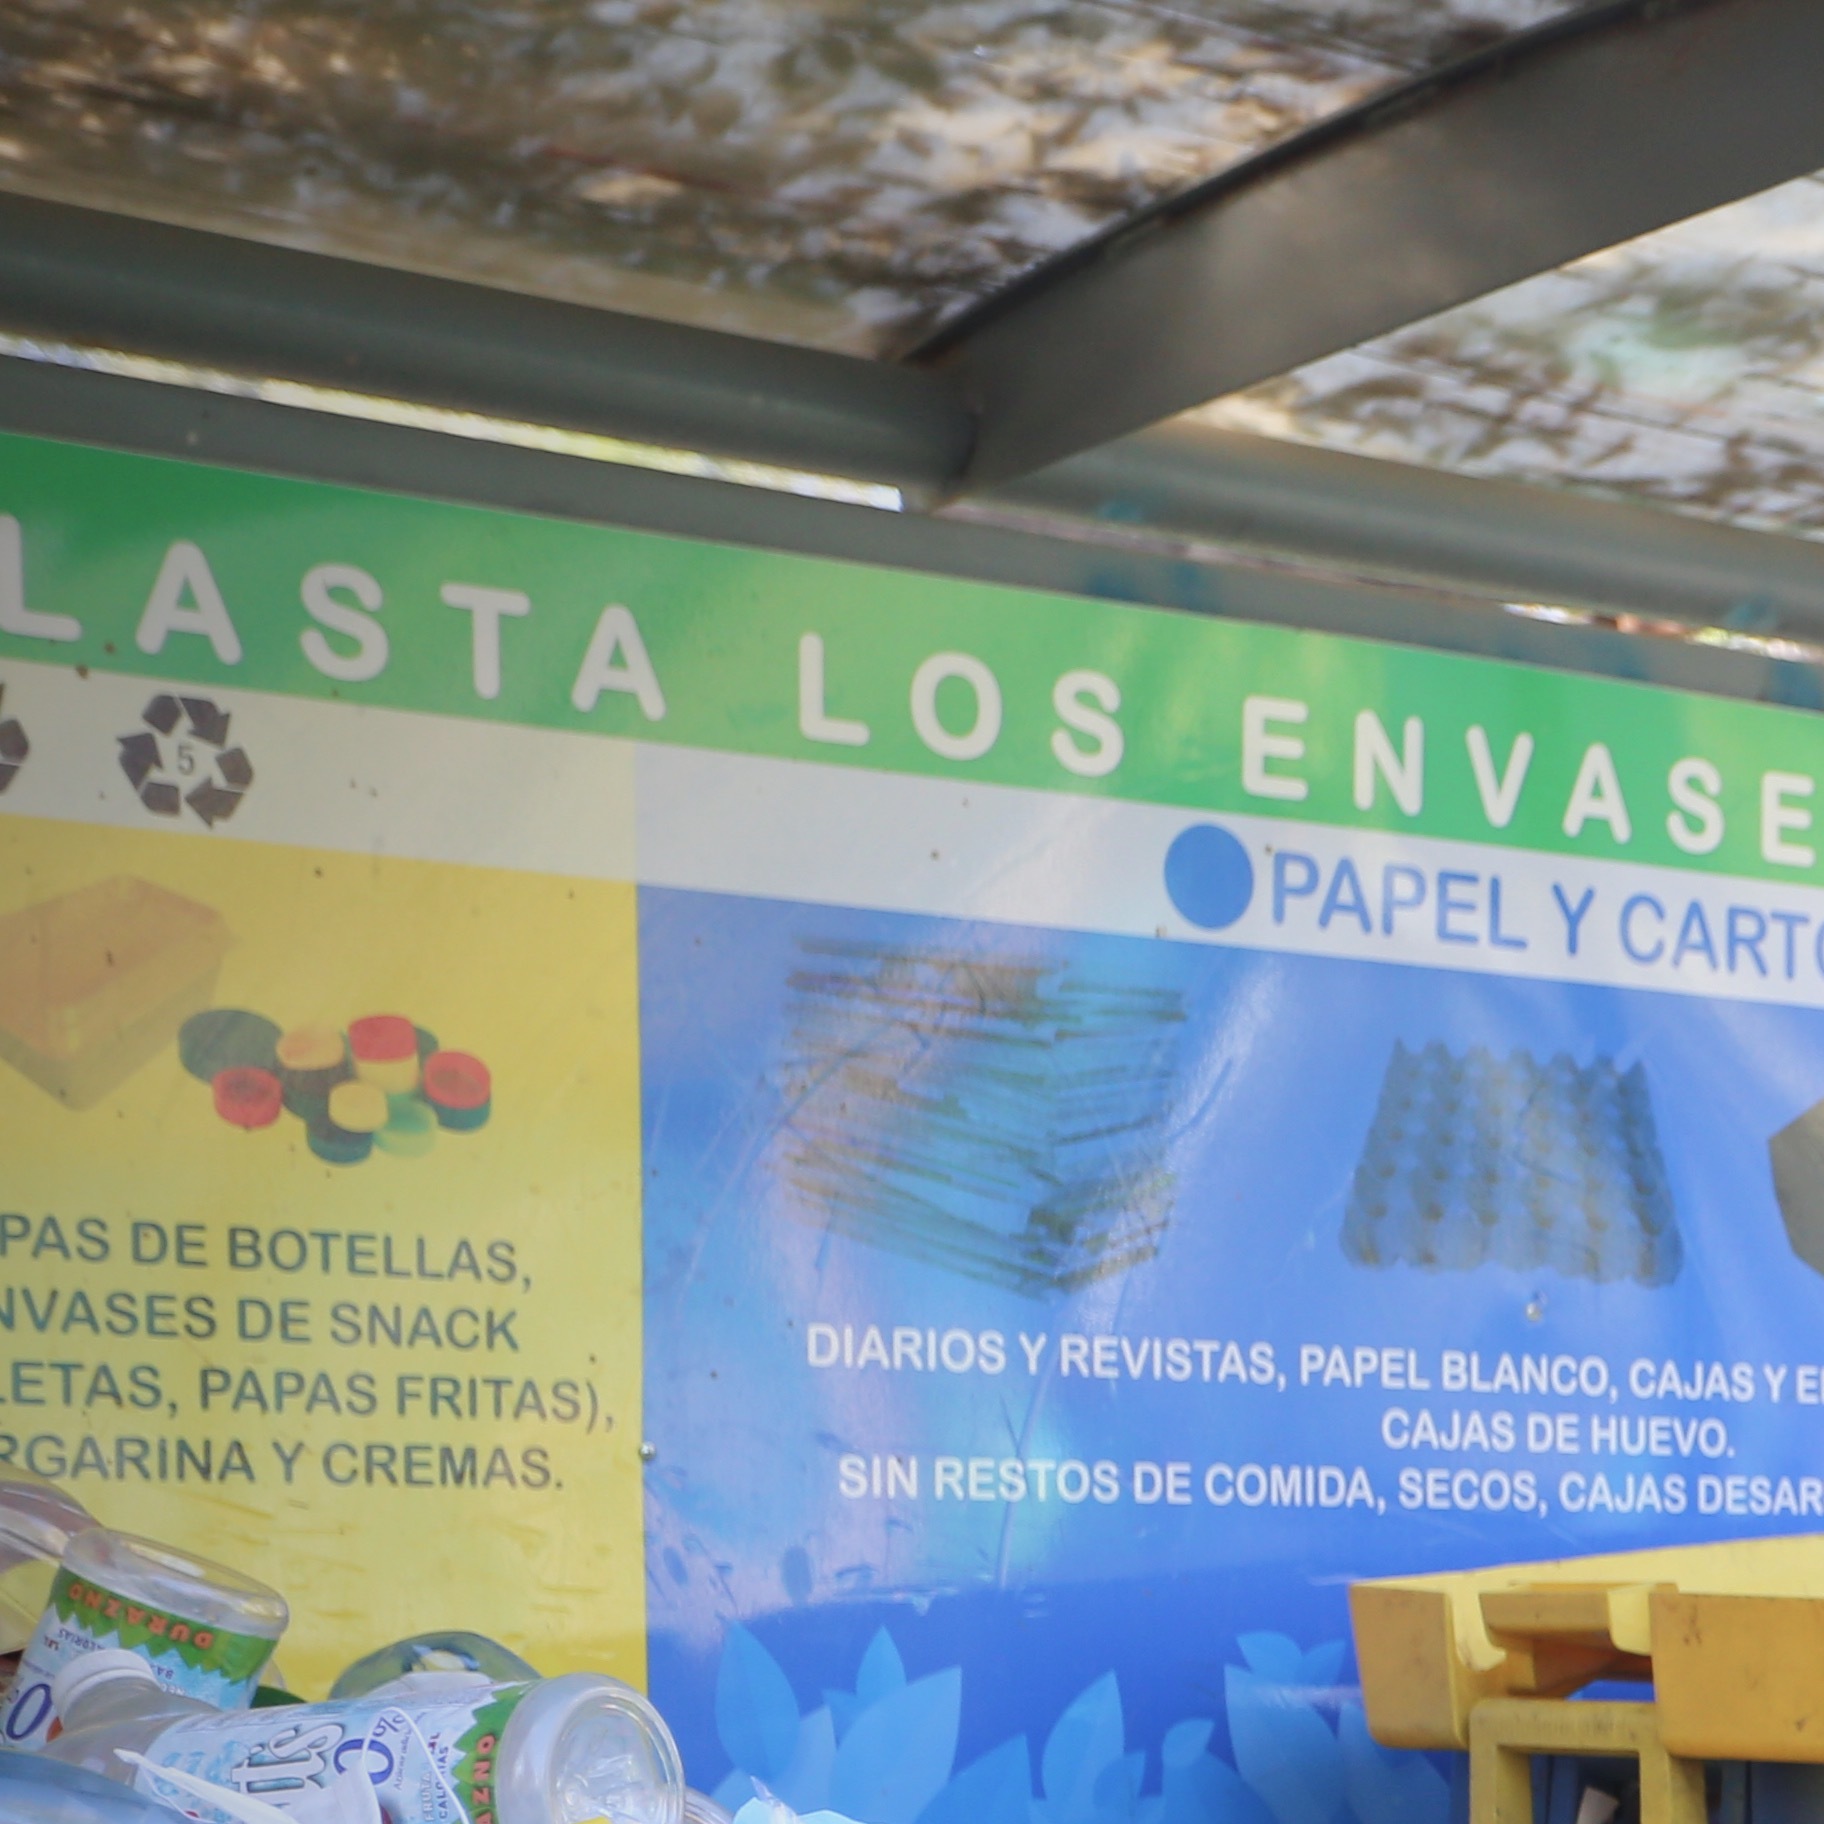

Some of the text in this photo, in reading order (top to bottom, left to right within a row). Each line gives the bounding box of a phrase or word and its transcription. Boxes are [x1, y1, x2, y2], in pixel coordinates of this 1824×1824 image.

[0, 513, 667, 722] LASTA
[799, 632, 1124, 777] LOS
[1271, 849, 1528, 951] PAPEL
[1552, 883, 1597, 958] Y
[131, 1220, 209, 1268] DE
[228, 1225, 533, 1293] BOTELLAS,
[237, 1298, 312, 1344] DE
[330, 1302, 520, 1353] SNACK
[0, 1360, 617, 1435] ETAS, PAPAS FRITAS),
[807, 1322, 1006, 1375] DIARIOS
[1018, 1331, 1048, 1376] Y
[1060, 1334, 1287, 1392] REVISTAS,
[1300, 1344, 1431, 1391] PAPEL
[1441, 1349, 1619, 1404] BLANCO,
[1628, 1357, 1756, 1402] CAJAS
[1763, 1363, 1789, 1403] Y
[271, 1439, 305, 1484] Y
[321, 1442, 564, 1491] CREMAS.
[1381, 1406, 1735, 1459] CAJAS DE HUEVO.
[837, 1453, 918, 1501] SIN
[934, 1456, 1120, 1505] RESTOS
[1132, 1461, 1193, 1506] DE
[1204, 1463, 1387, 1517] COMIDA,
[1398, 1467, 1548, 1518] SECOS,
[1558, 1471, 1688, 1515] CAJAS
[68, 1582, 215, 1650] DURAZNO
